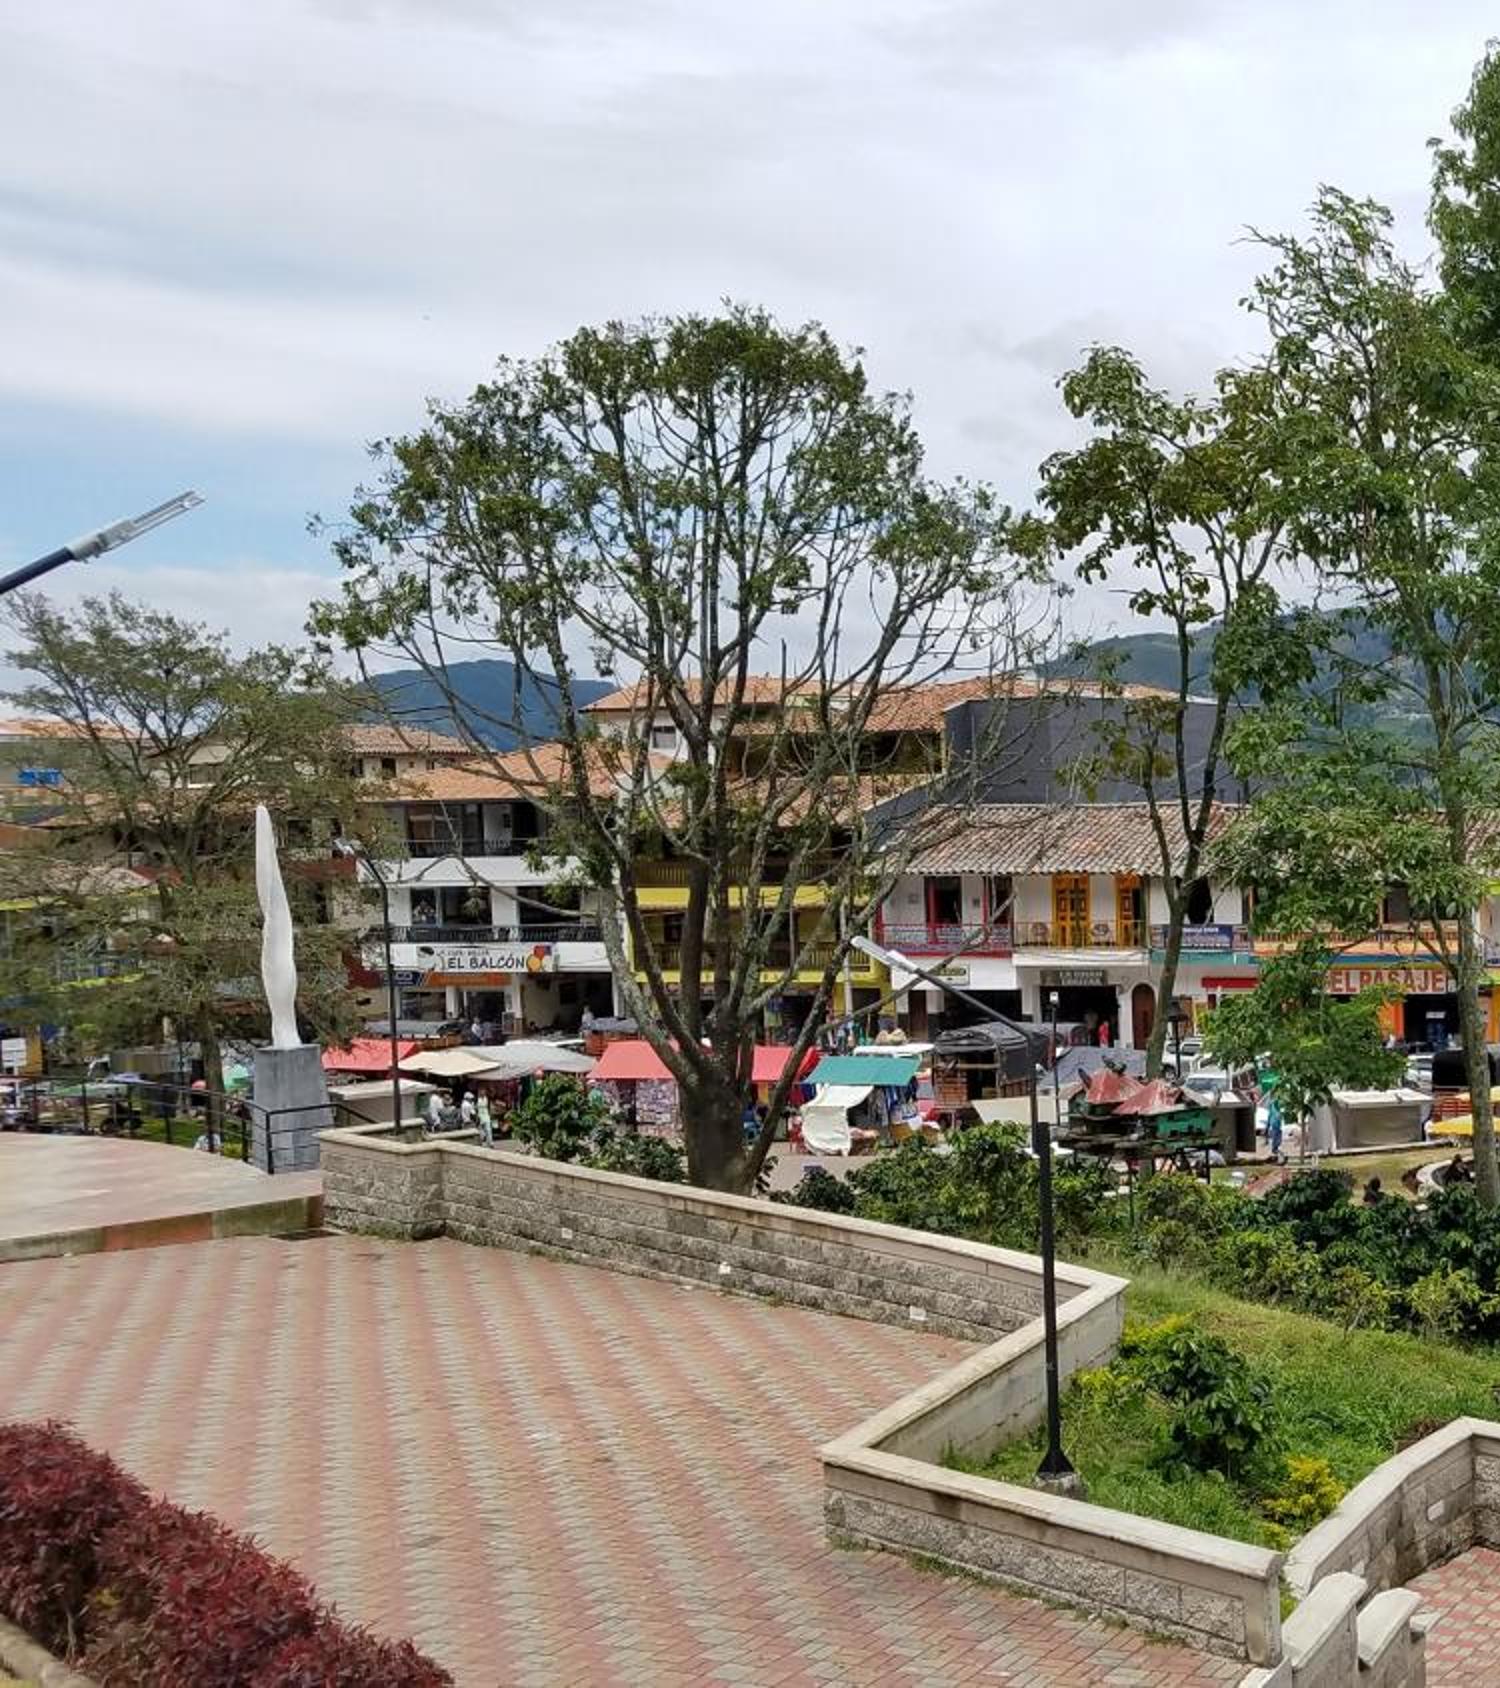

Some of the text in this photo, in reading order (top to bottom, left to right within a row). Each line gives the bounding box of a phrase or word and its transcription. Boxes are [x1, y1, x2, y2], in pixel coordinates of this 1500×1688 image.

[448, 953, 525, 969] EL BALCÓN
[1329, 970, 1446, 993] EL PASAJE
